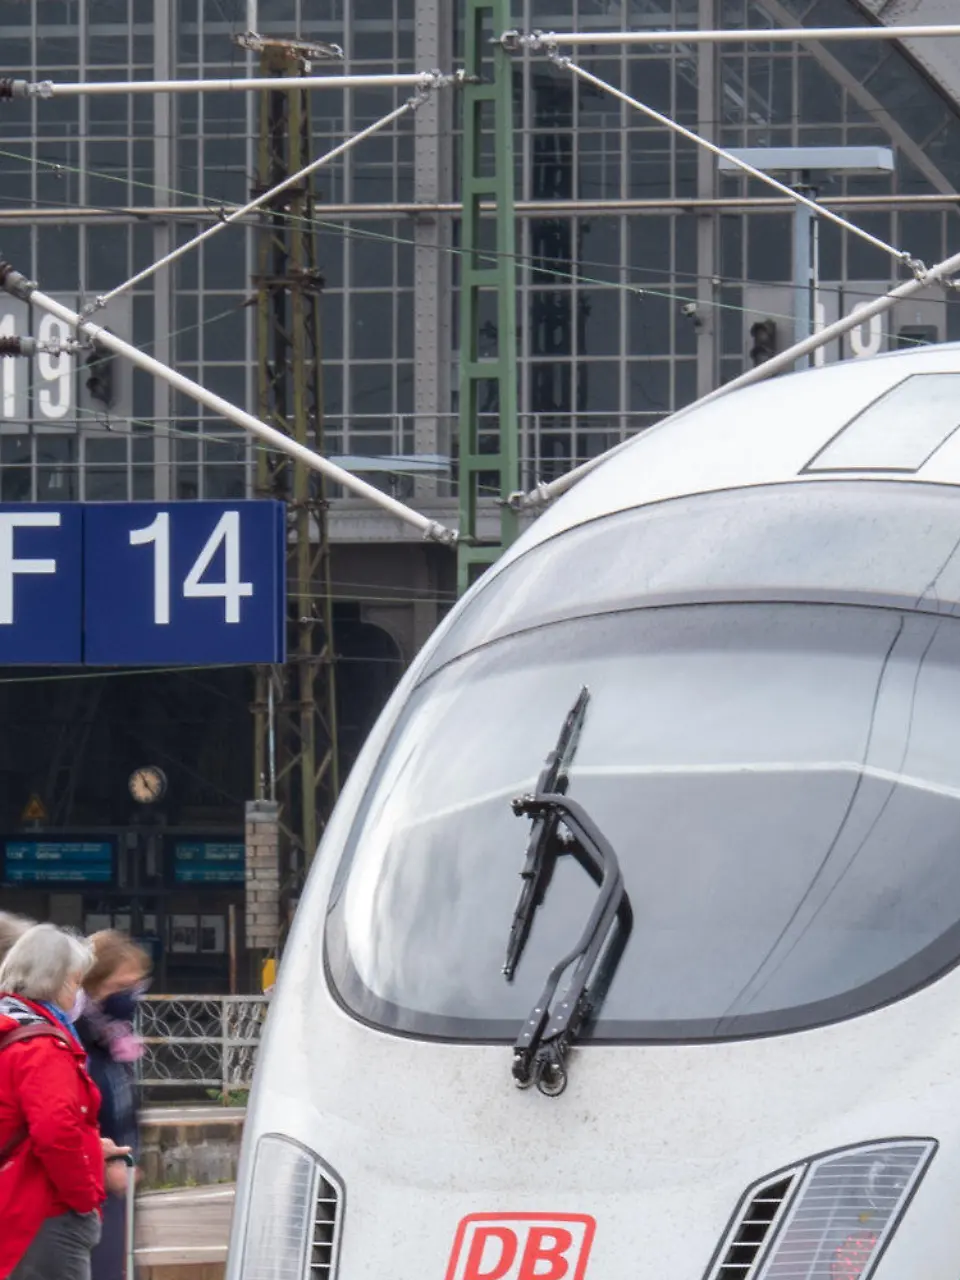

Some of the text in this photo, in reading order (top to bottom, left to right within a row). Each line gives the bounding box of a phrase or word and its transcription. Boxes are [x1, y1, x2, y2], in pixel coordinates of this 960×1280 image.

[0, 313, 71, 418] 19
[0, 511, 253, 624] F 14
